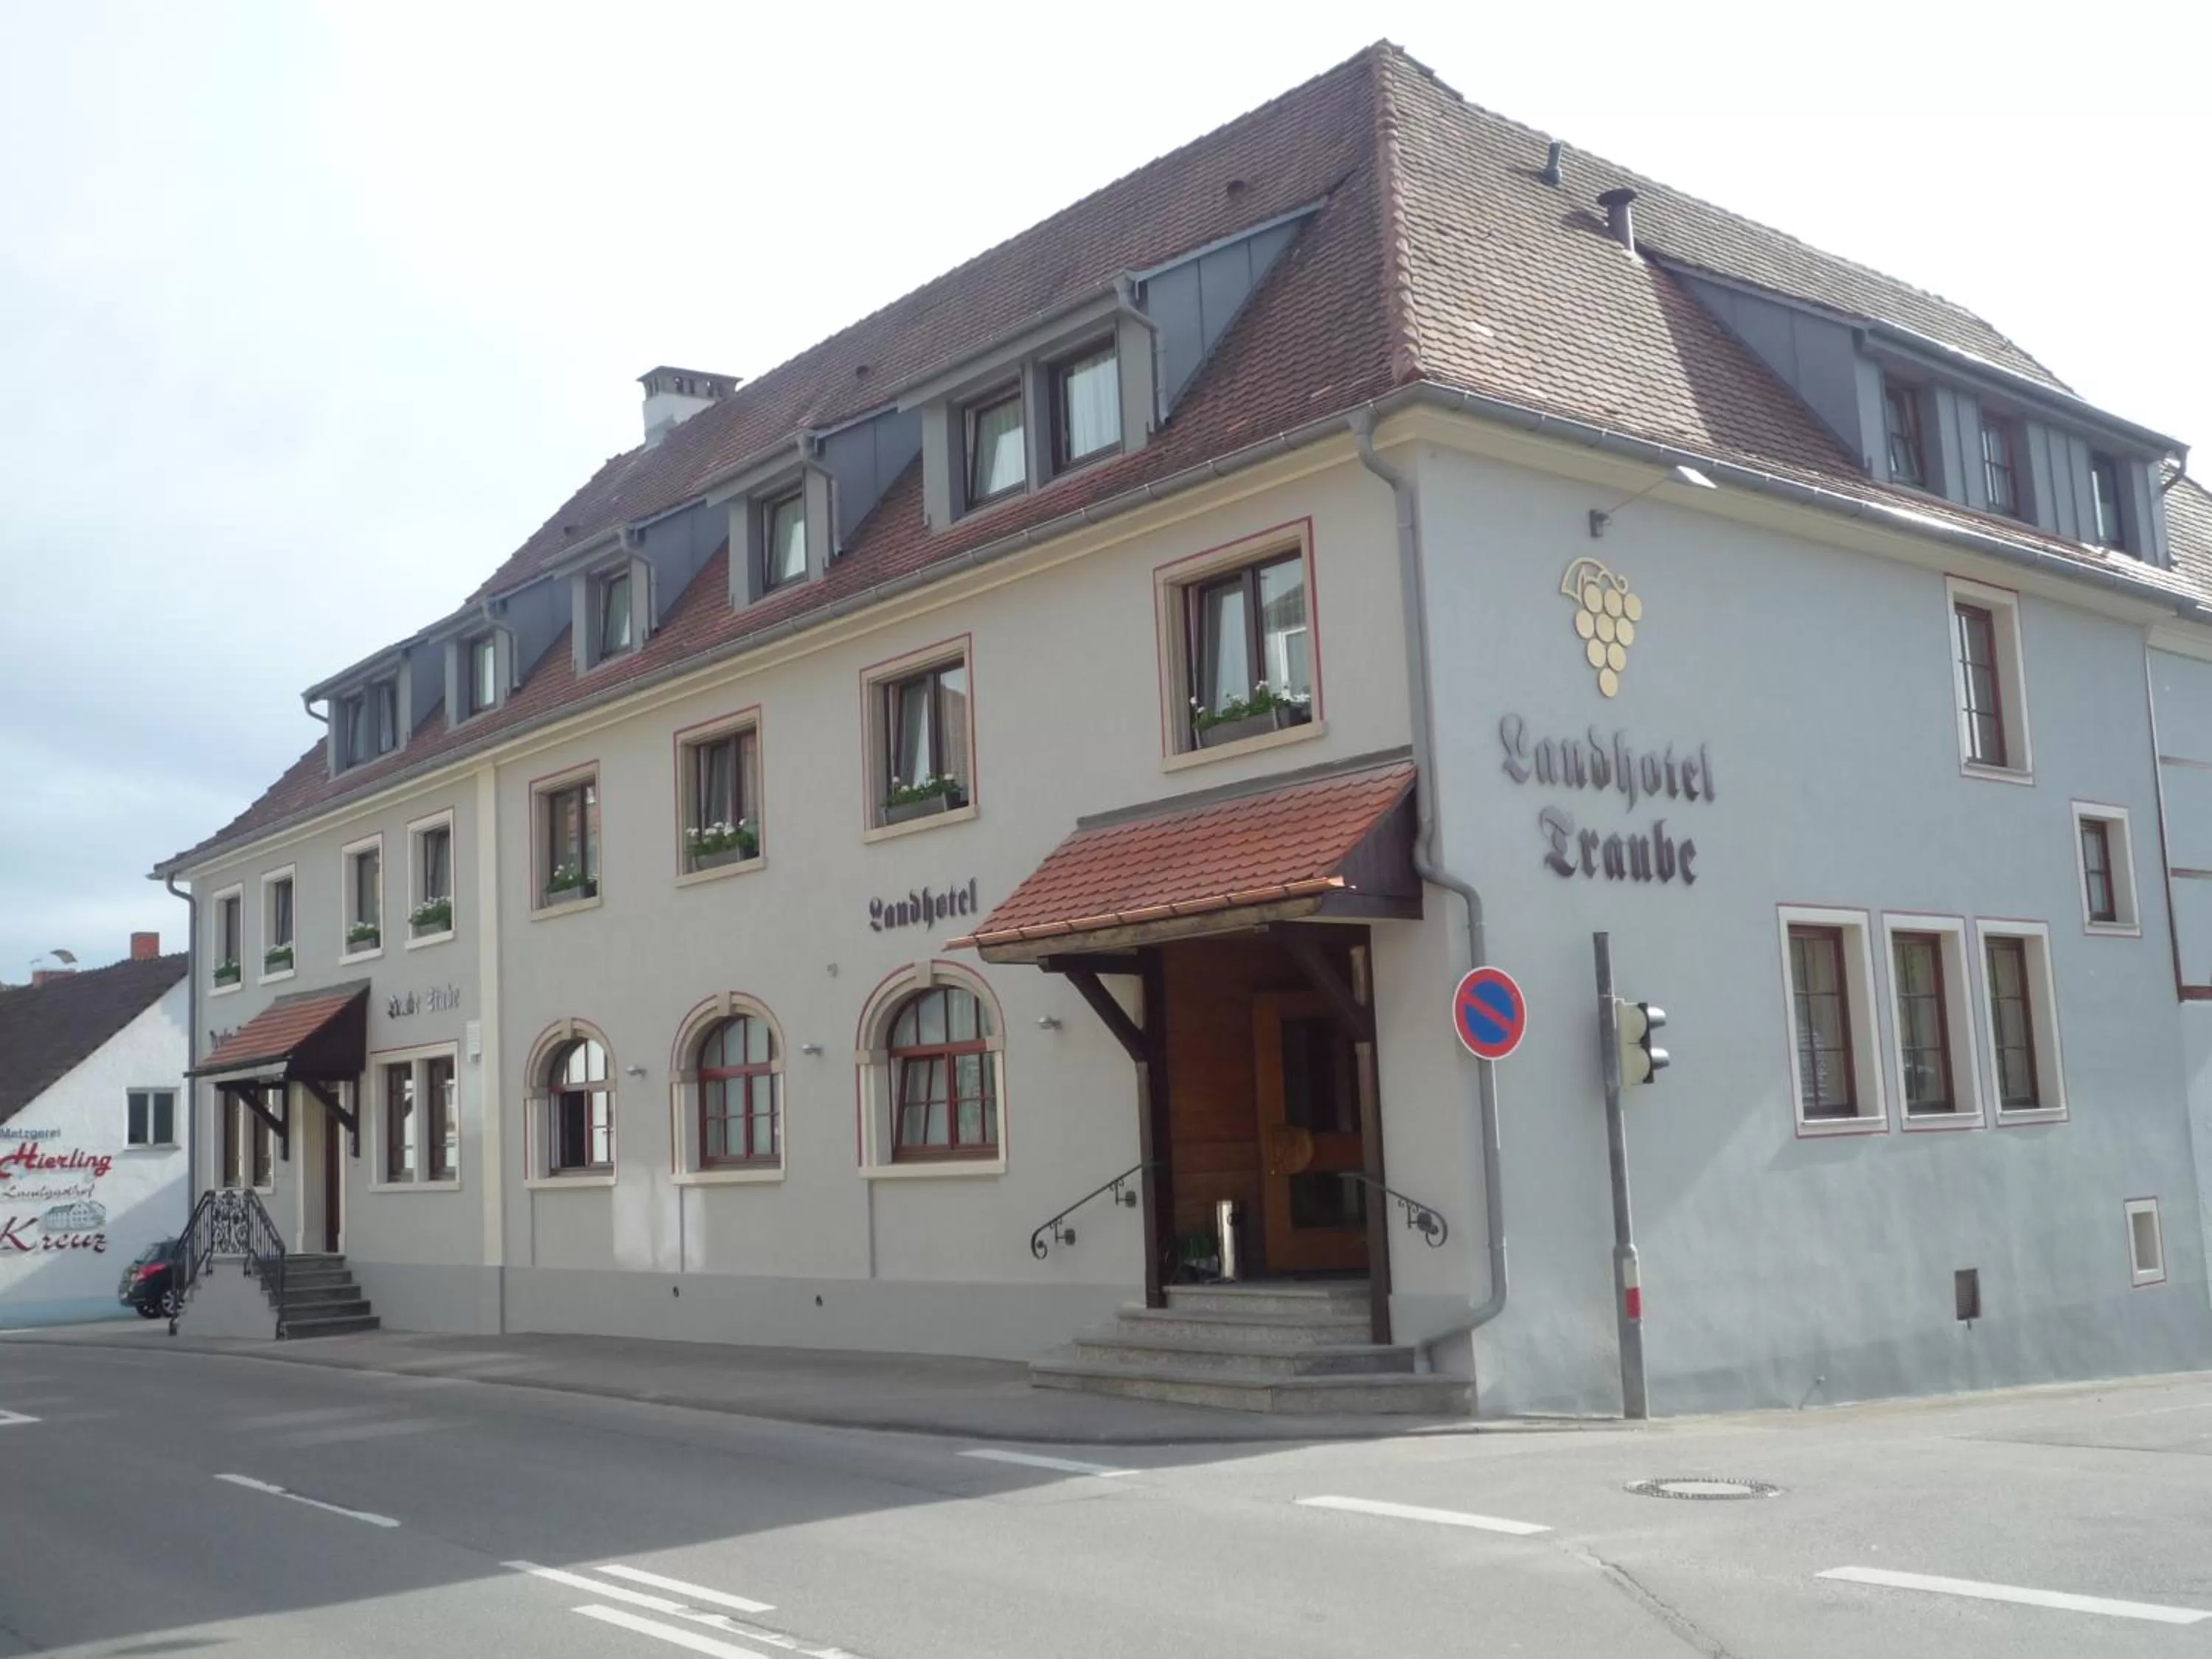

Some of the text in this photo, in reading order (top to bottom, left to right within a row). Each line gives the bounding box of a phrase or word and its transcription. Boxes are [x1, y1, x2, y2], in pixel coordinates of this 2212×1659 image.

[1499, 712, 1714, 814] Landhotel
[1538, 806, 1697, 886] Traube
[869, 875, 978, 932] Landhotel
[0, 1127, 60, 1139] Metzgerei
[0, 1141, 112, 1178] Hierling
[0, 1217, 107, 1253] Kreuz
